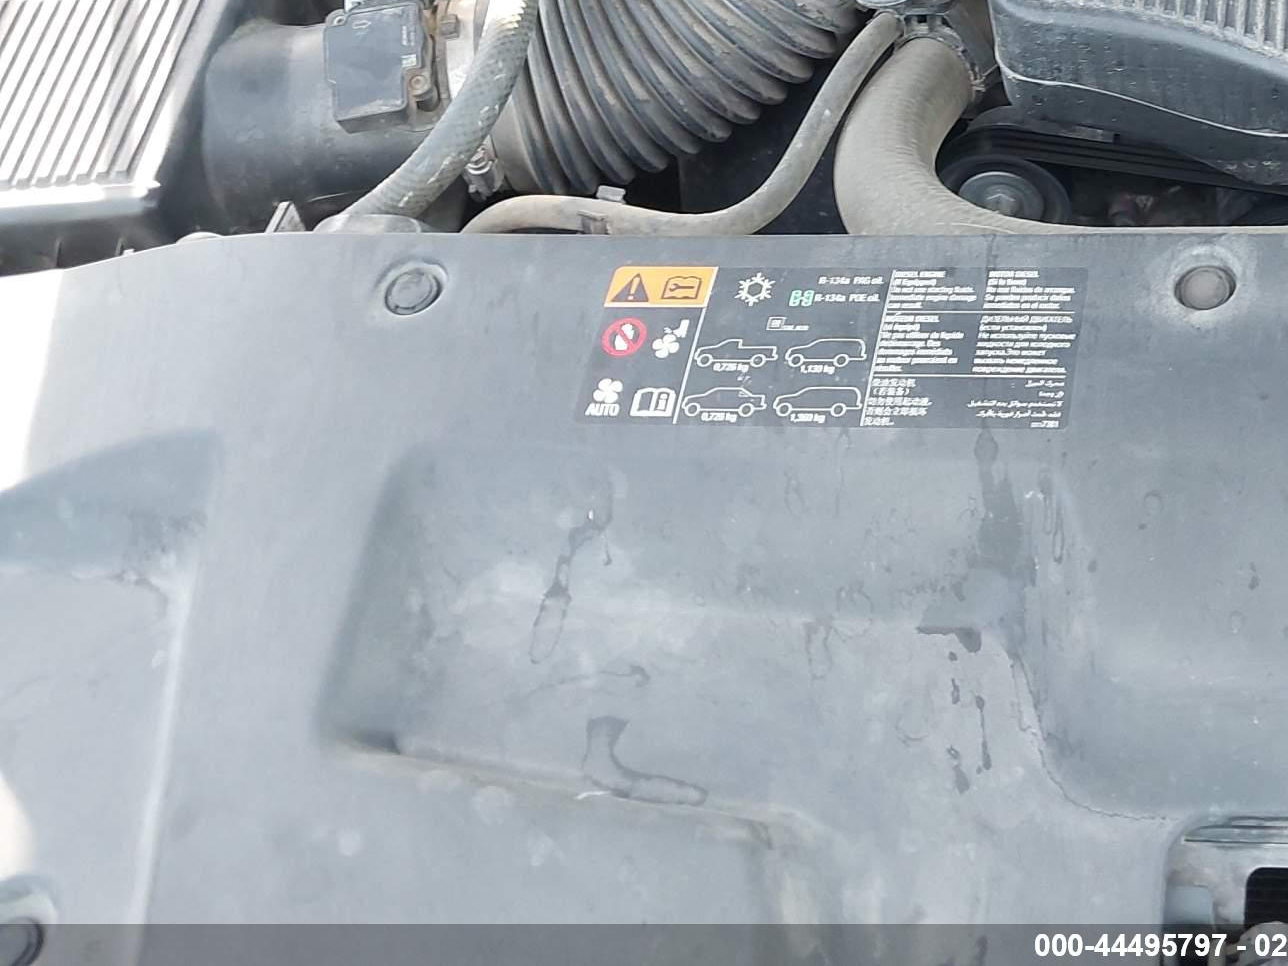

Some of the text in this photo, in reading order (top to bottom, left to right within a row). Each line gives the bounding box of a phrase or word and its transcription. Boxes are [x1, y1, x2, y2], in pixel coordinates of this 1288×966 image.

[737, 362, 750, 373] kg
[822, 365, 836, 375] kg
[585, 403, 620, 416] AUTO
[725, 412, 738, 423] kg
[814, 414, 826, 424] kg
